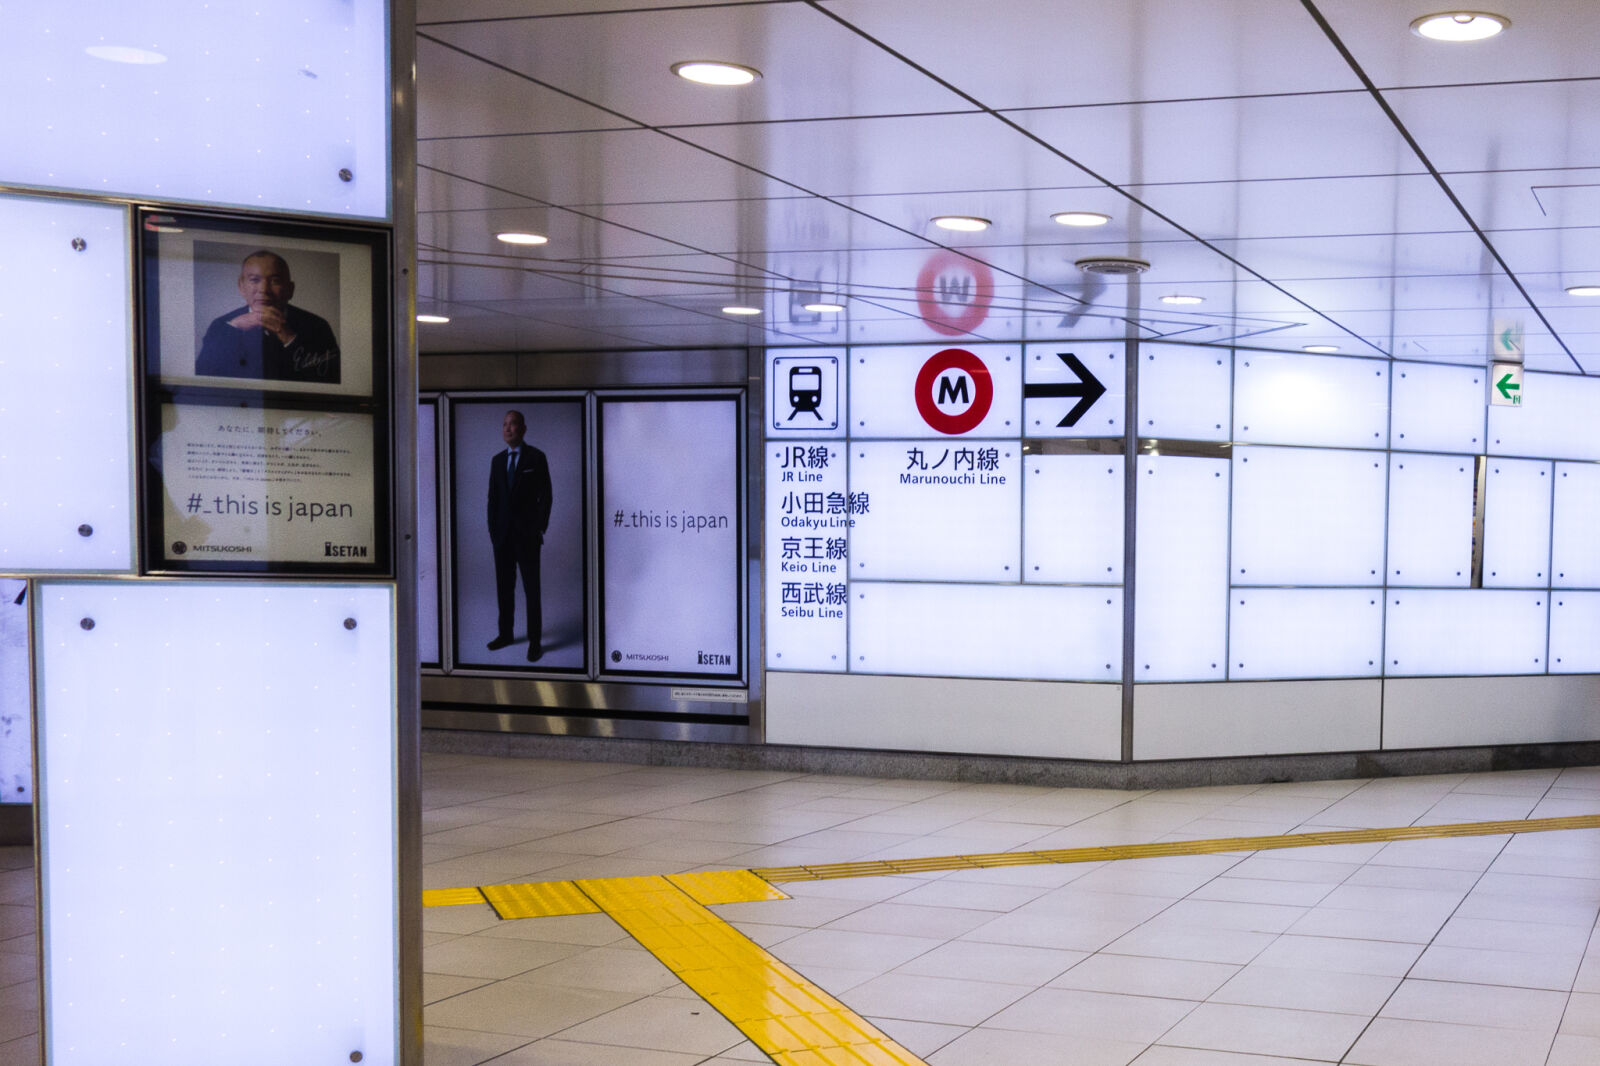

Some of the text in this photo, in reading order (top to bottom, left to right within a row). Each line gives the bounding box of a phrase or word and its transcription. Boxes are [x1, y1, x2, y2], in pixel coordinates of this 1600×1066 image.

[937, 376, 970, 404] M
[780, 446, 829, 469] JR線
[906, 447, 999, 471] 丸ノ内線
[781, 471, 823, 482] JR Line
[899, 473, 1006, 484] Marunouchi Line
[265, 496, 281, 516] is
[287, 497, 353, 522] japan
[780, 491, 870, 515] 小田急線
[666, 511, 678, 528] is
[681, 510, 729, 533] japan
[781, 516, 856, 530] Odakyu Line
[192, 545, 252, 553] MITSUKOSHI
[324, 541, 367, 558] ISETAN
[780, 537, 847, 560] 京王線
[781, 562, 837, 573] Keio Line
[780, 581, 847, 606] 西武線
[781, 607, 844, 618] Seibu Line
[625, 653, 669, 662] MITSUKOSHI
[697, 650, 731, 666] ISETAN
